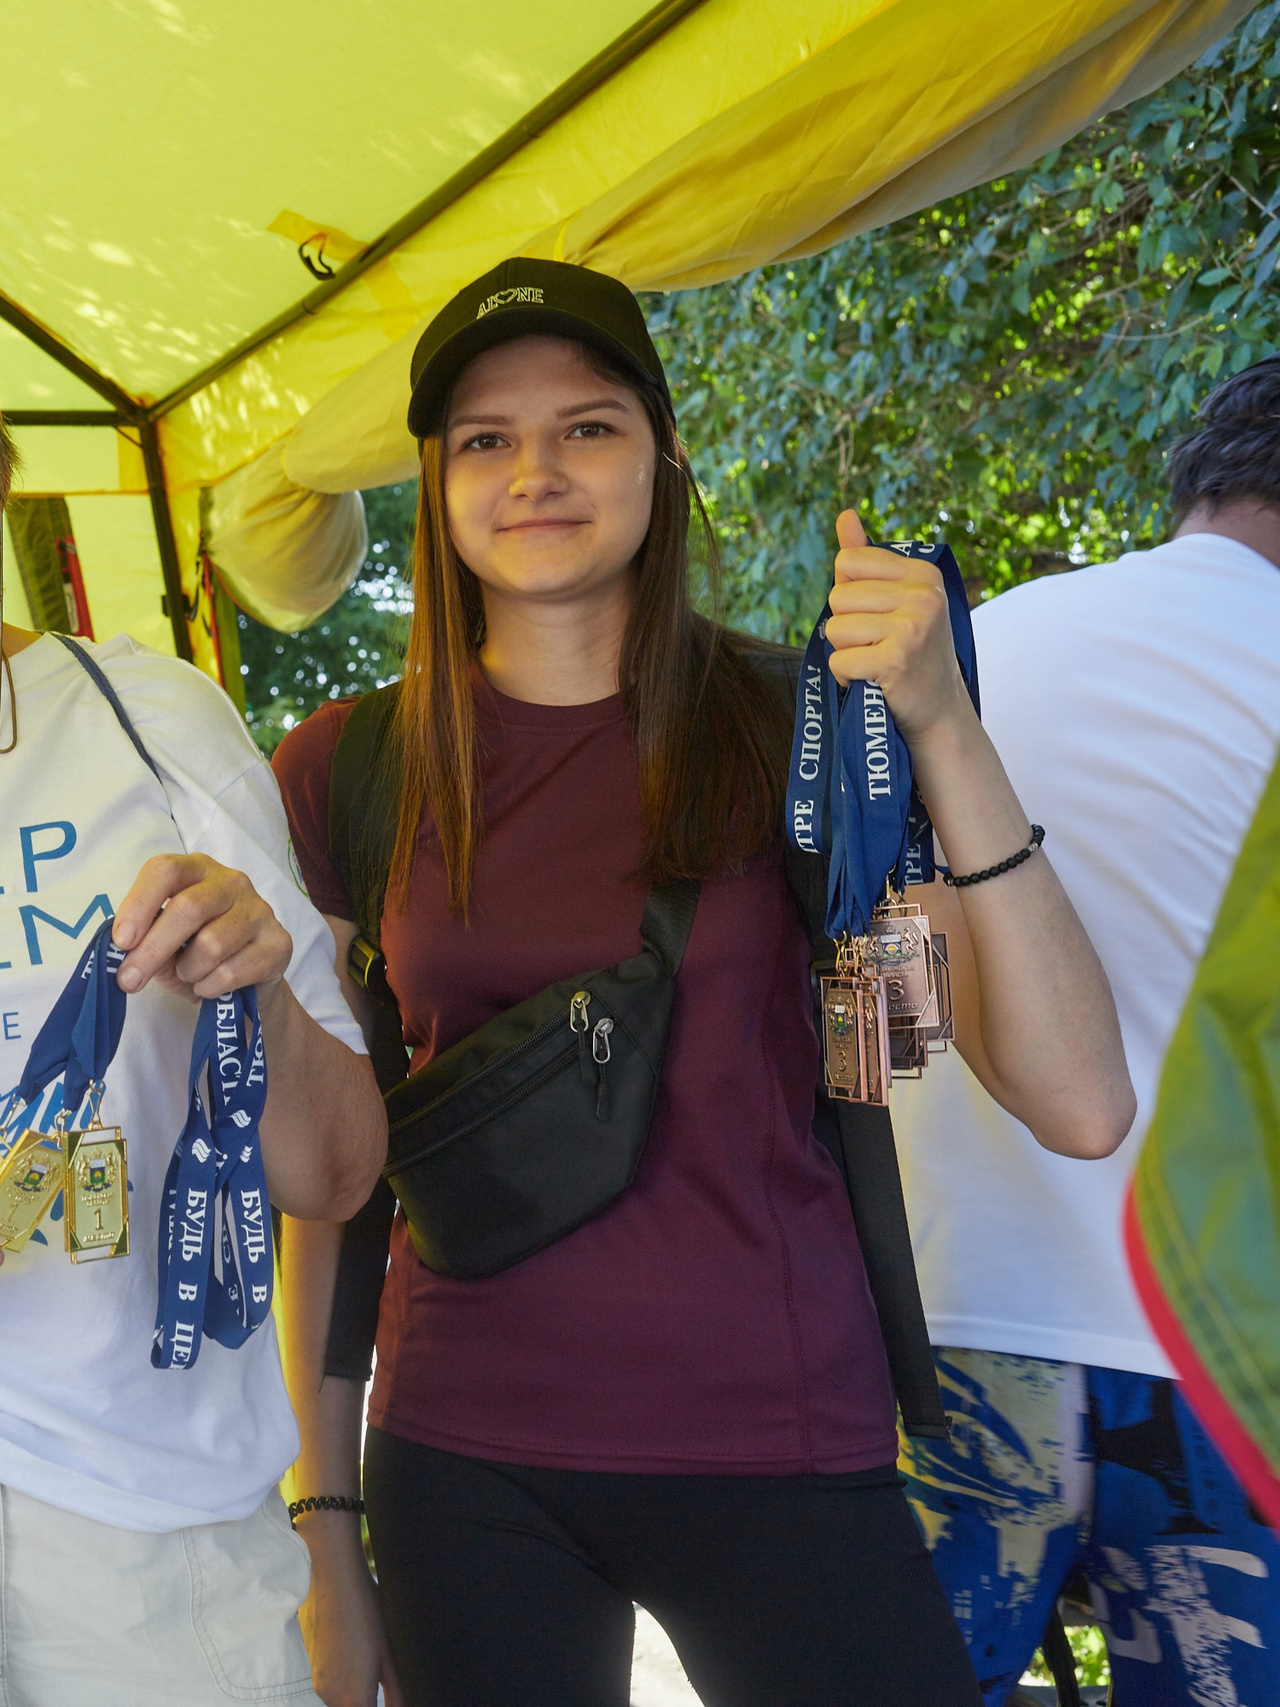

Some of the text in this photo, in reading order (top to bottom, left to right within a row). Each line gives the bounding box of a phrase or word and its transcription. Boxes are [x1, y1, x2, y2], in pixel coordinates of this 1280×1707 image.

[799, 664, 822, 781] СПОРТА!
[94, 1208, 104, 1231] 1
[179, 1188, 208, 1261] БУДЬ
[240, 1188, 267, 1304] БУДЬ В
[178, 1281, 198, 1301] В
